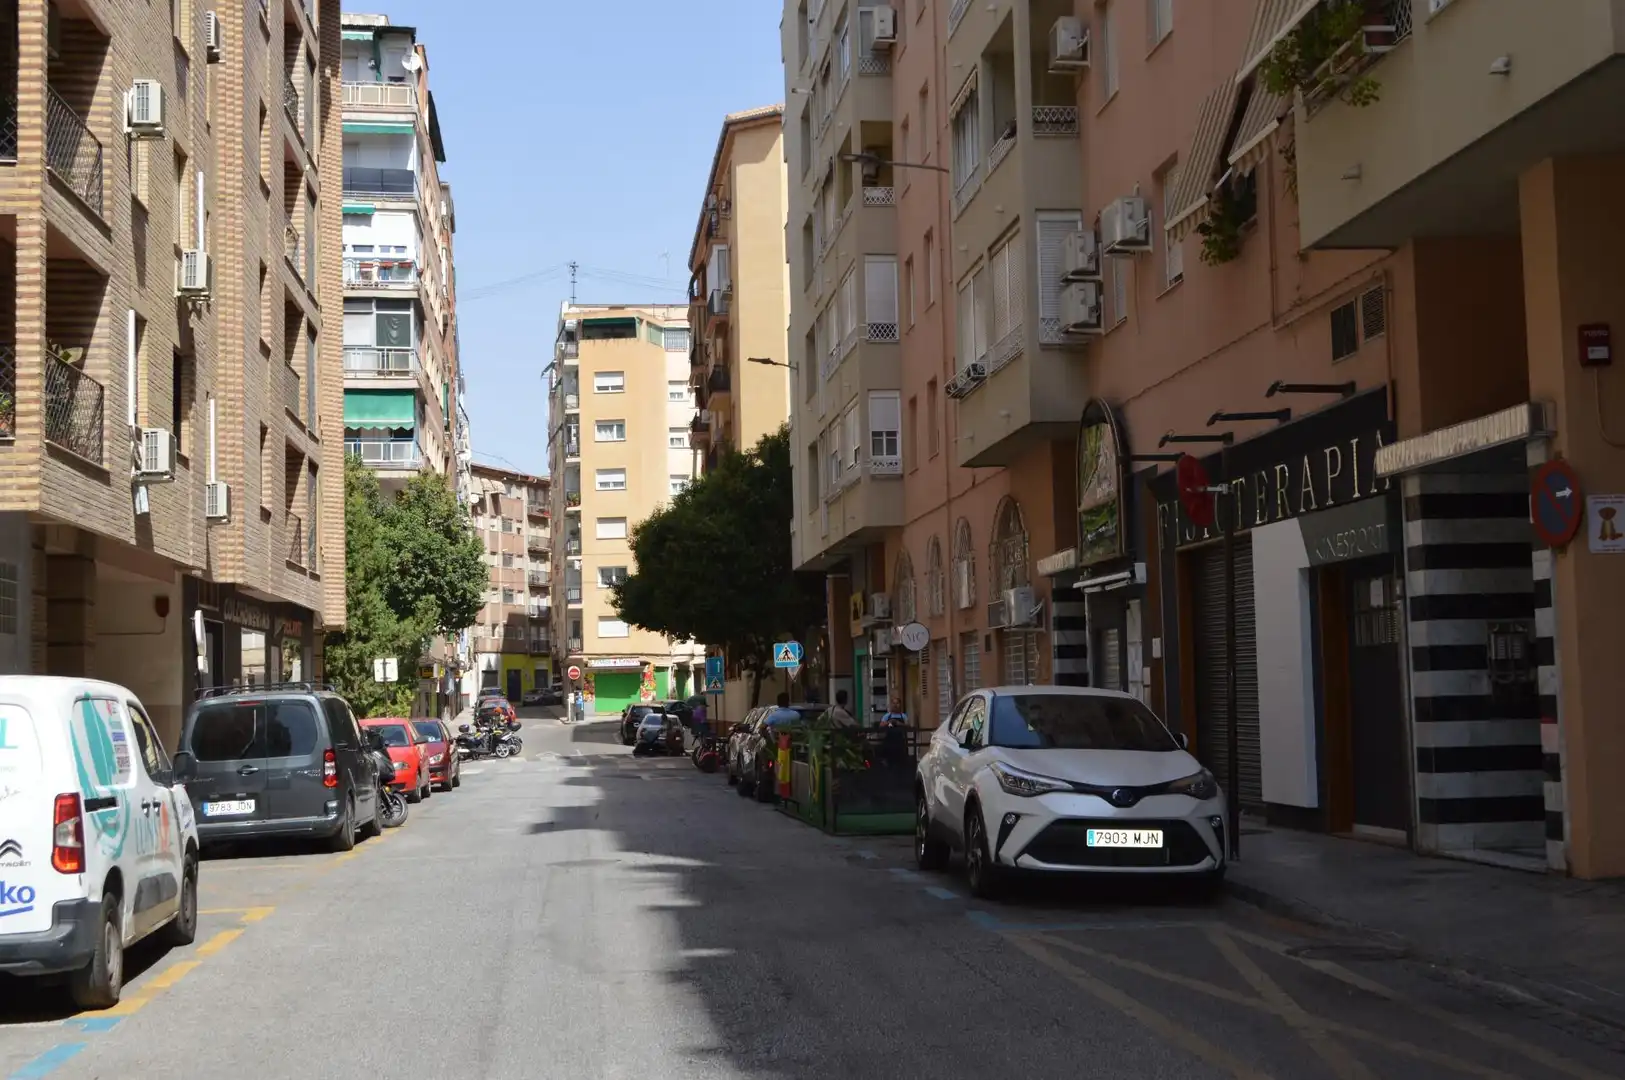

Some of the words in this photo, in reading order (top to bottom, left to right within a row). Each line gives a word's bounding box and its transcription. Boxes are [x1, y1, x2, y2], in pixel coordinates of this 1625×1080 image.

[1158, 429, 1392, 548] FIOTERAPIA
[1096, 832, 1128, 844] 7903
[1133, 832, 1159, 845] MJN
